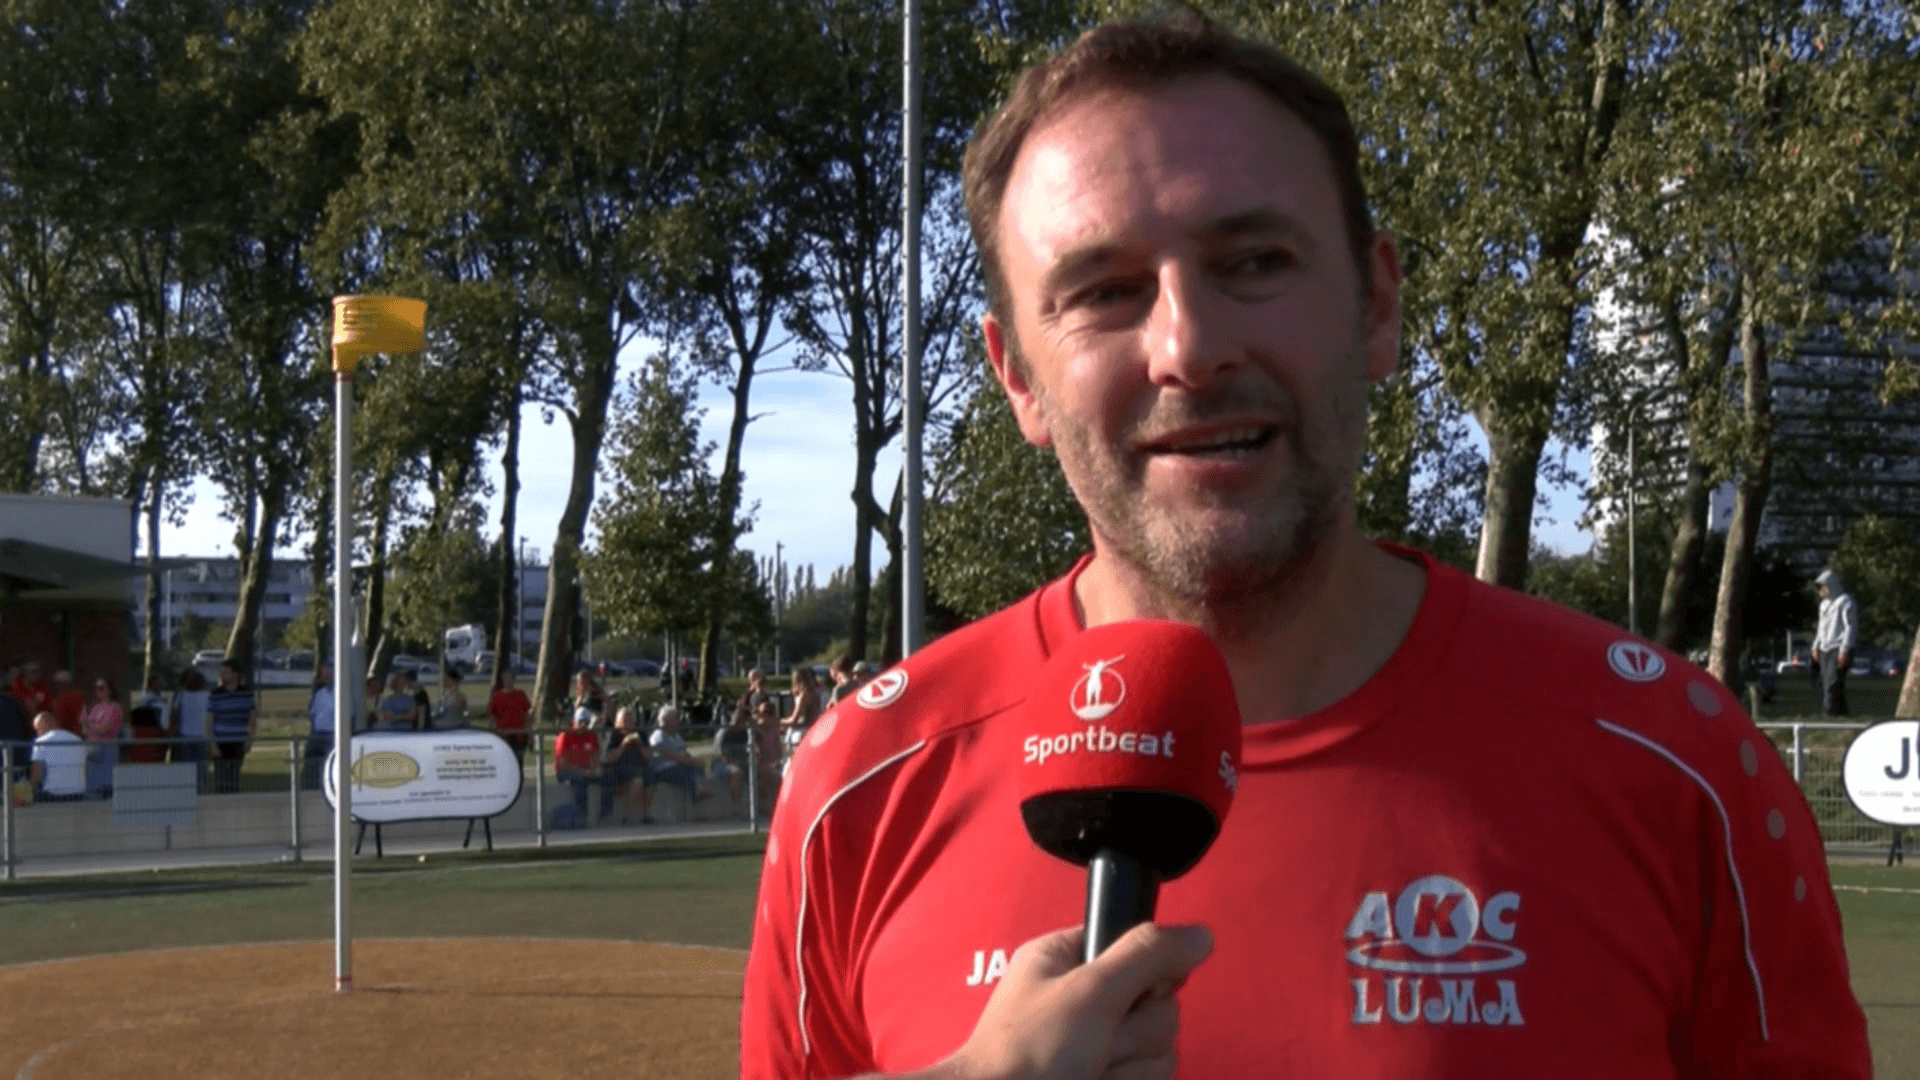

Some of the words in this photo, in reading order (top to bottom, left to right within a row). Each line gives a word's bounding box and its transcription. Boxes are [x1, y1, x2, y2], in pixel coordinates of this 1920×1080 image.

[1022, 725, 1175, 765] Sportbeat
[1346, 887, 1522, 944] AKC
[1351, 976, 1526, 1025] LUMA
